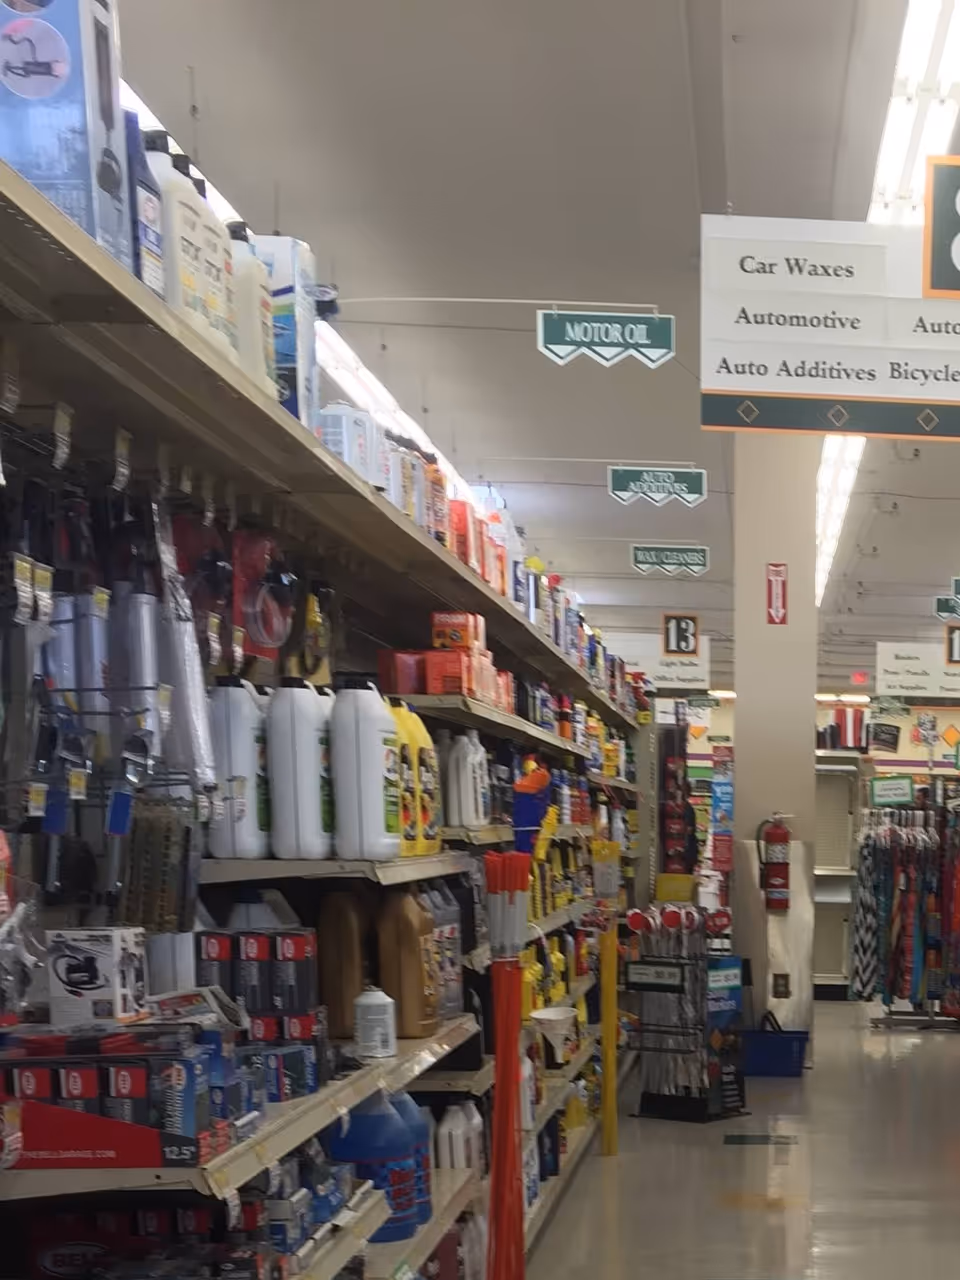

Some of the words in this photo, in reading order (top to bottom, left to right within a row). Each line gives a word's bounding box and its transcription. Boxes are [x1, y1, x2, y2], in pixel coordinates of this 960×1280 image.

[738, 255, 779, 275] Car
[784, 257, 855, 279] Waxes
[733, 306, 862, 331] Automotive
[564, 321, 623, 343] MOTOR
[624, 324, 651, 344] OIL
[715, 357, 769, 377] Auto
[776, 360, 877, 383] Additives
[667, 619, 697, 652] 13
